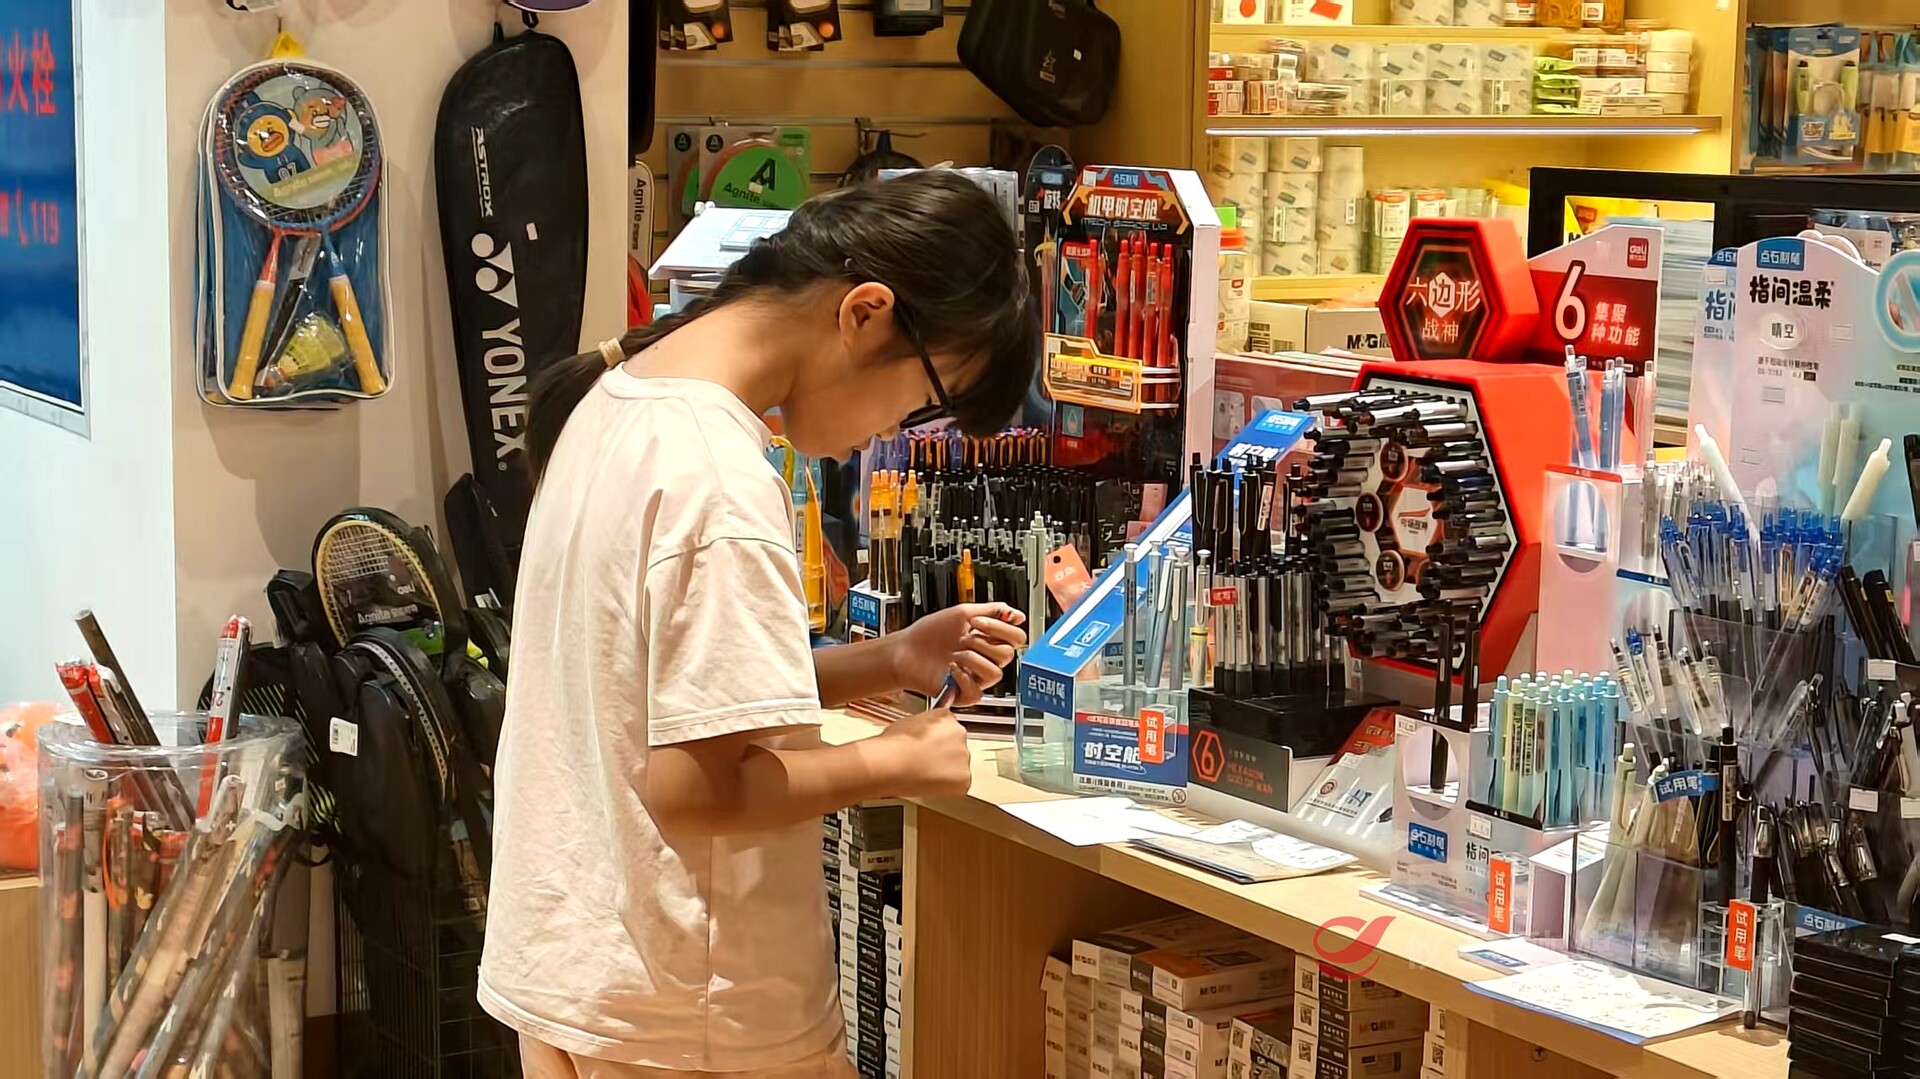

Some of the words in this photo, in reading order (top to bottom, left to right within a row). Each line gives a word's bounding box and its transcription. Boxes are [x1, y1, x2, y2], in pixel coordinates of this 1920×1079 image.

[0, 27, 57, 117] 火栓
[475, 127, 494, 217] ASTROX
[1087, 194, 1160, 220] 机甲时空舱
[1405, 271, 1481, 319] 六边形
[1555, 265, 1586, 340] 6
[1749, 274, 1832, 310] 指间温柔
[1422, 318, 1460, 344] 战神
[1594, 301, 1628, 325] 集聚
[1771, 321, 1795, 340] 晴空
[1346, 334, 1379, 351] M&G
[1591, 323, 1641, 347] 种功能
[482, 318, 529, 460] YONEX
[1144, 715, 1159, 758] 试用笔
[1658, 772, 1699, 796] 试用笔
[1493, 870, 1506, 923] 试用笔
[1734, 909, 1749, 962] 试用笔
